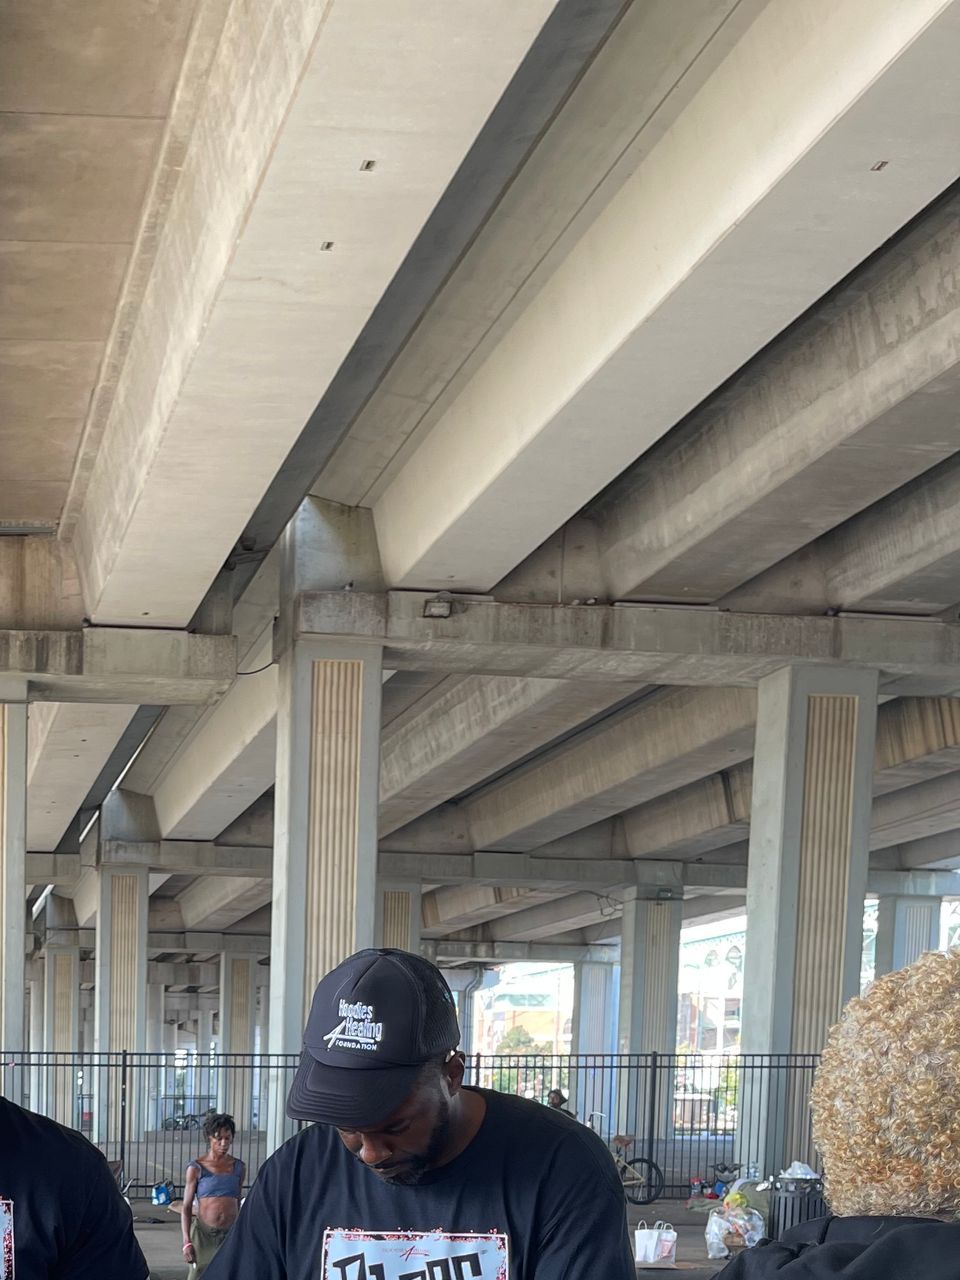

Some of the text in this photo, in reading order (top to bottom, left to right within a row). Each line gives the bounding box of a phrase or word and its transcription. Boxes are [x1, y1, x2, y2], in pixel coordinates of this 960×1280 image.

[338, 998, 373, 1019] Hoodies
[345, 1018, 383, 1042] Healing
[335, 1040, 377, 1051] FOUNDATION
